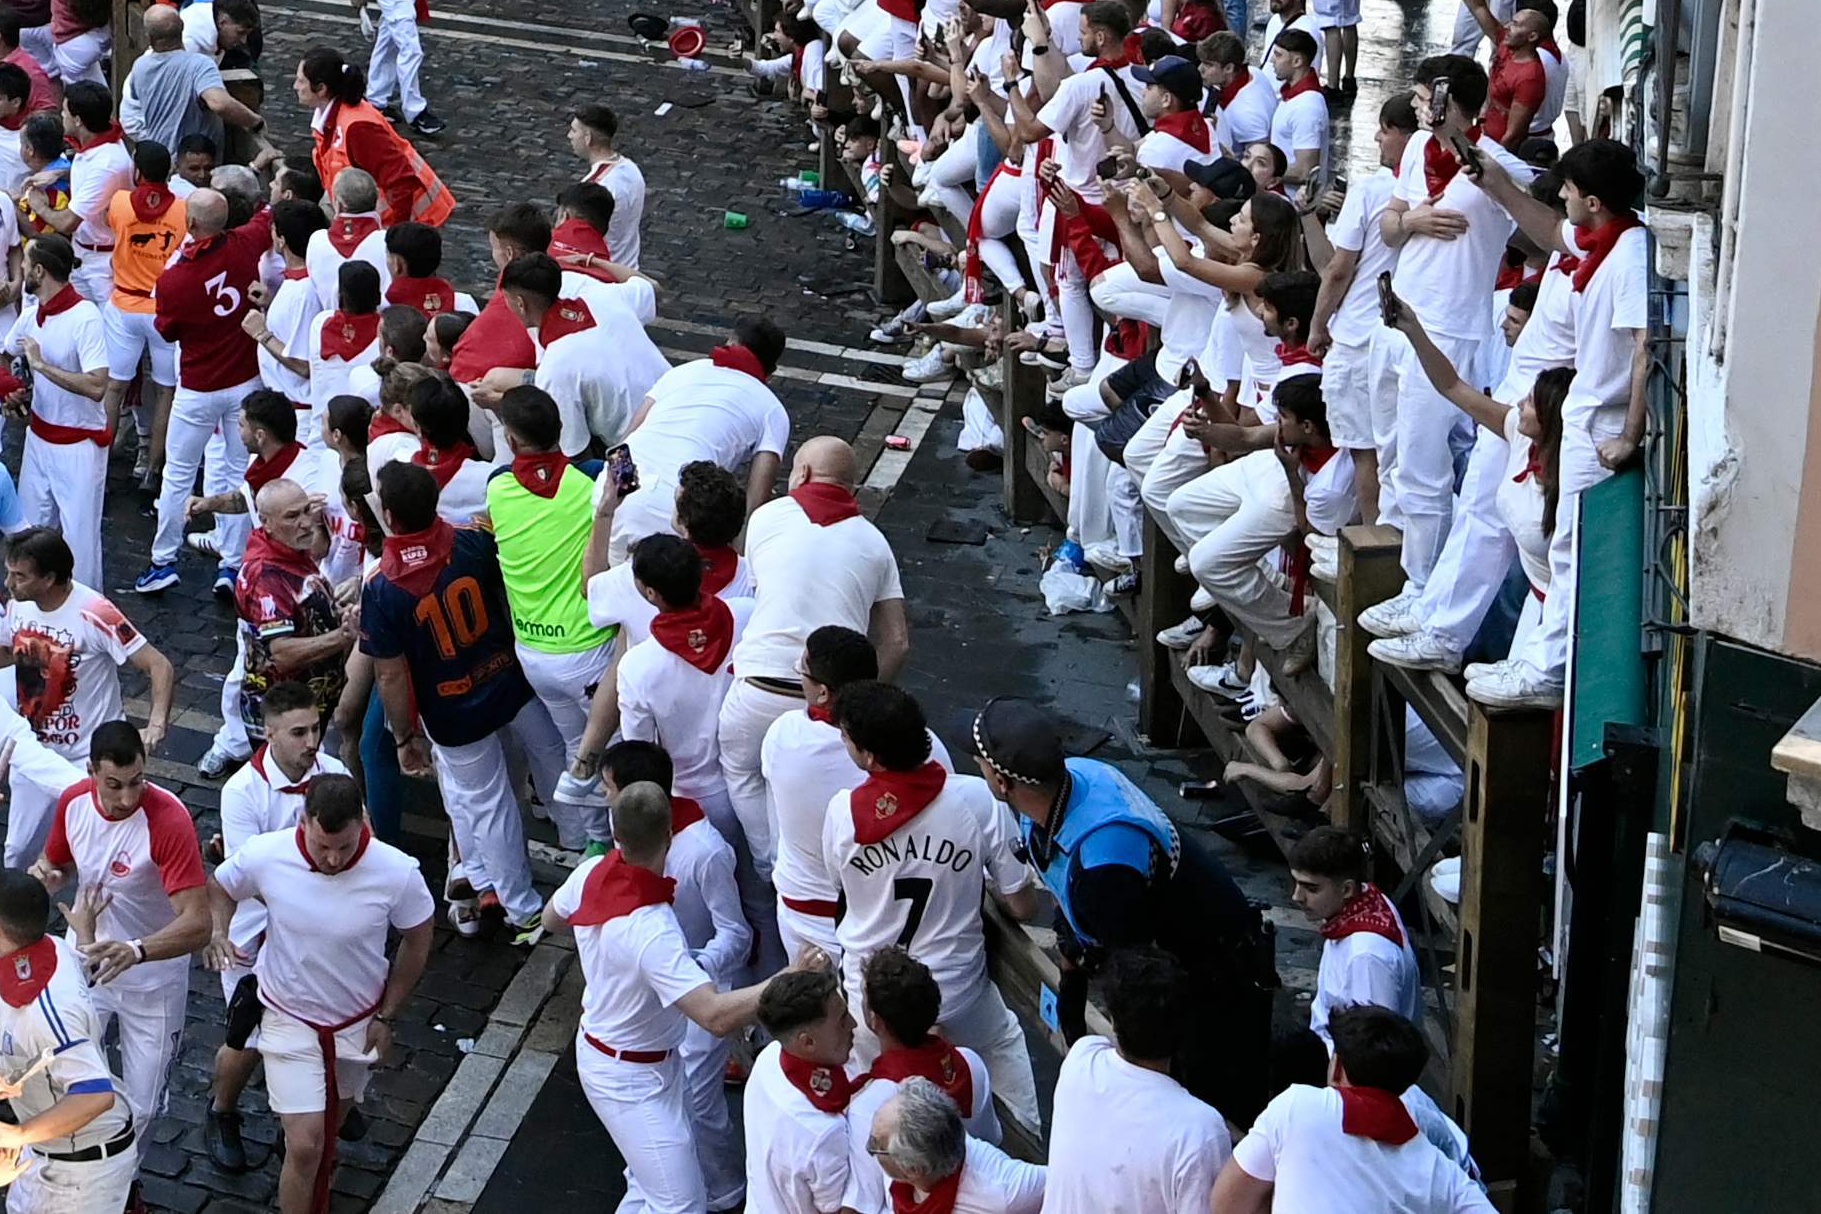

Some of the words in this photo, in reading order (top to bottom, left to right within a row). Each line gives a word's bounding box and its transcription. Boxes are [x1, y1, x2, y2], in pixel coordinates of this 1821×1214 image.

[204, 270, 241, 317] 3
[414, 575, 489, 661] 10
[850, 833, 973, 877] RONALDO
[893, 877, 934, 951] 7
